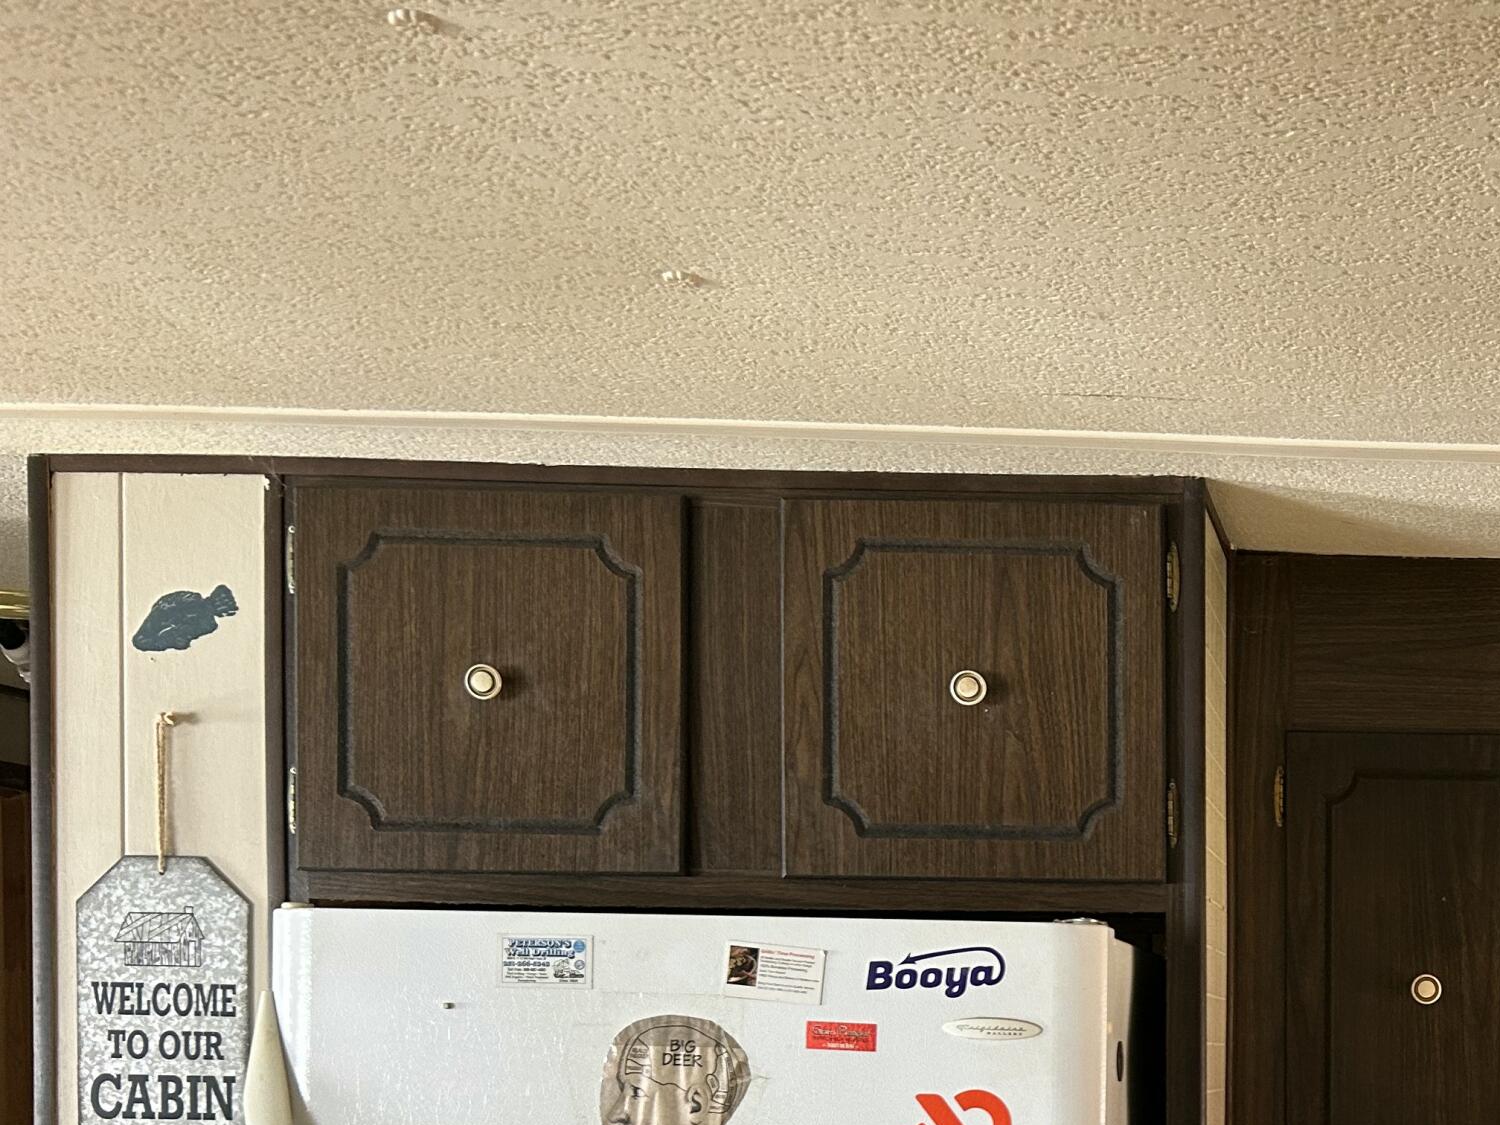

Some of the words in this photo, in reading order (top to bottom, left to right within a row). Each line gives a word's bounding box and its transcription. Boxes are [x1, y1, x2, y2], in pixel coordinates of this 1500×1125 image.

[508, 938, 572, 948] PETERSON'S
[866, 955, 1005, 998] Booya
[91, 981, 237, 1018] WELCOME
[107, 1029, 149, 1059] TO
[158, 1031, 225, 1061] OUR
[662, 1053, 703, 1067] DEER
[670, 1039, 697, 1053] BIG
[90, 1073, 236, 1121] CABIN
